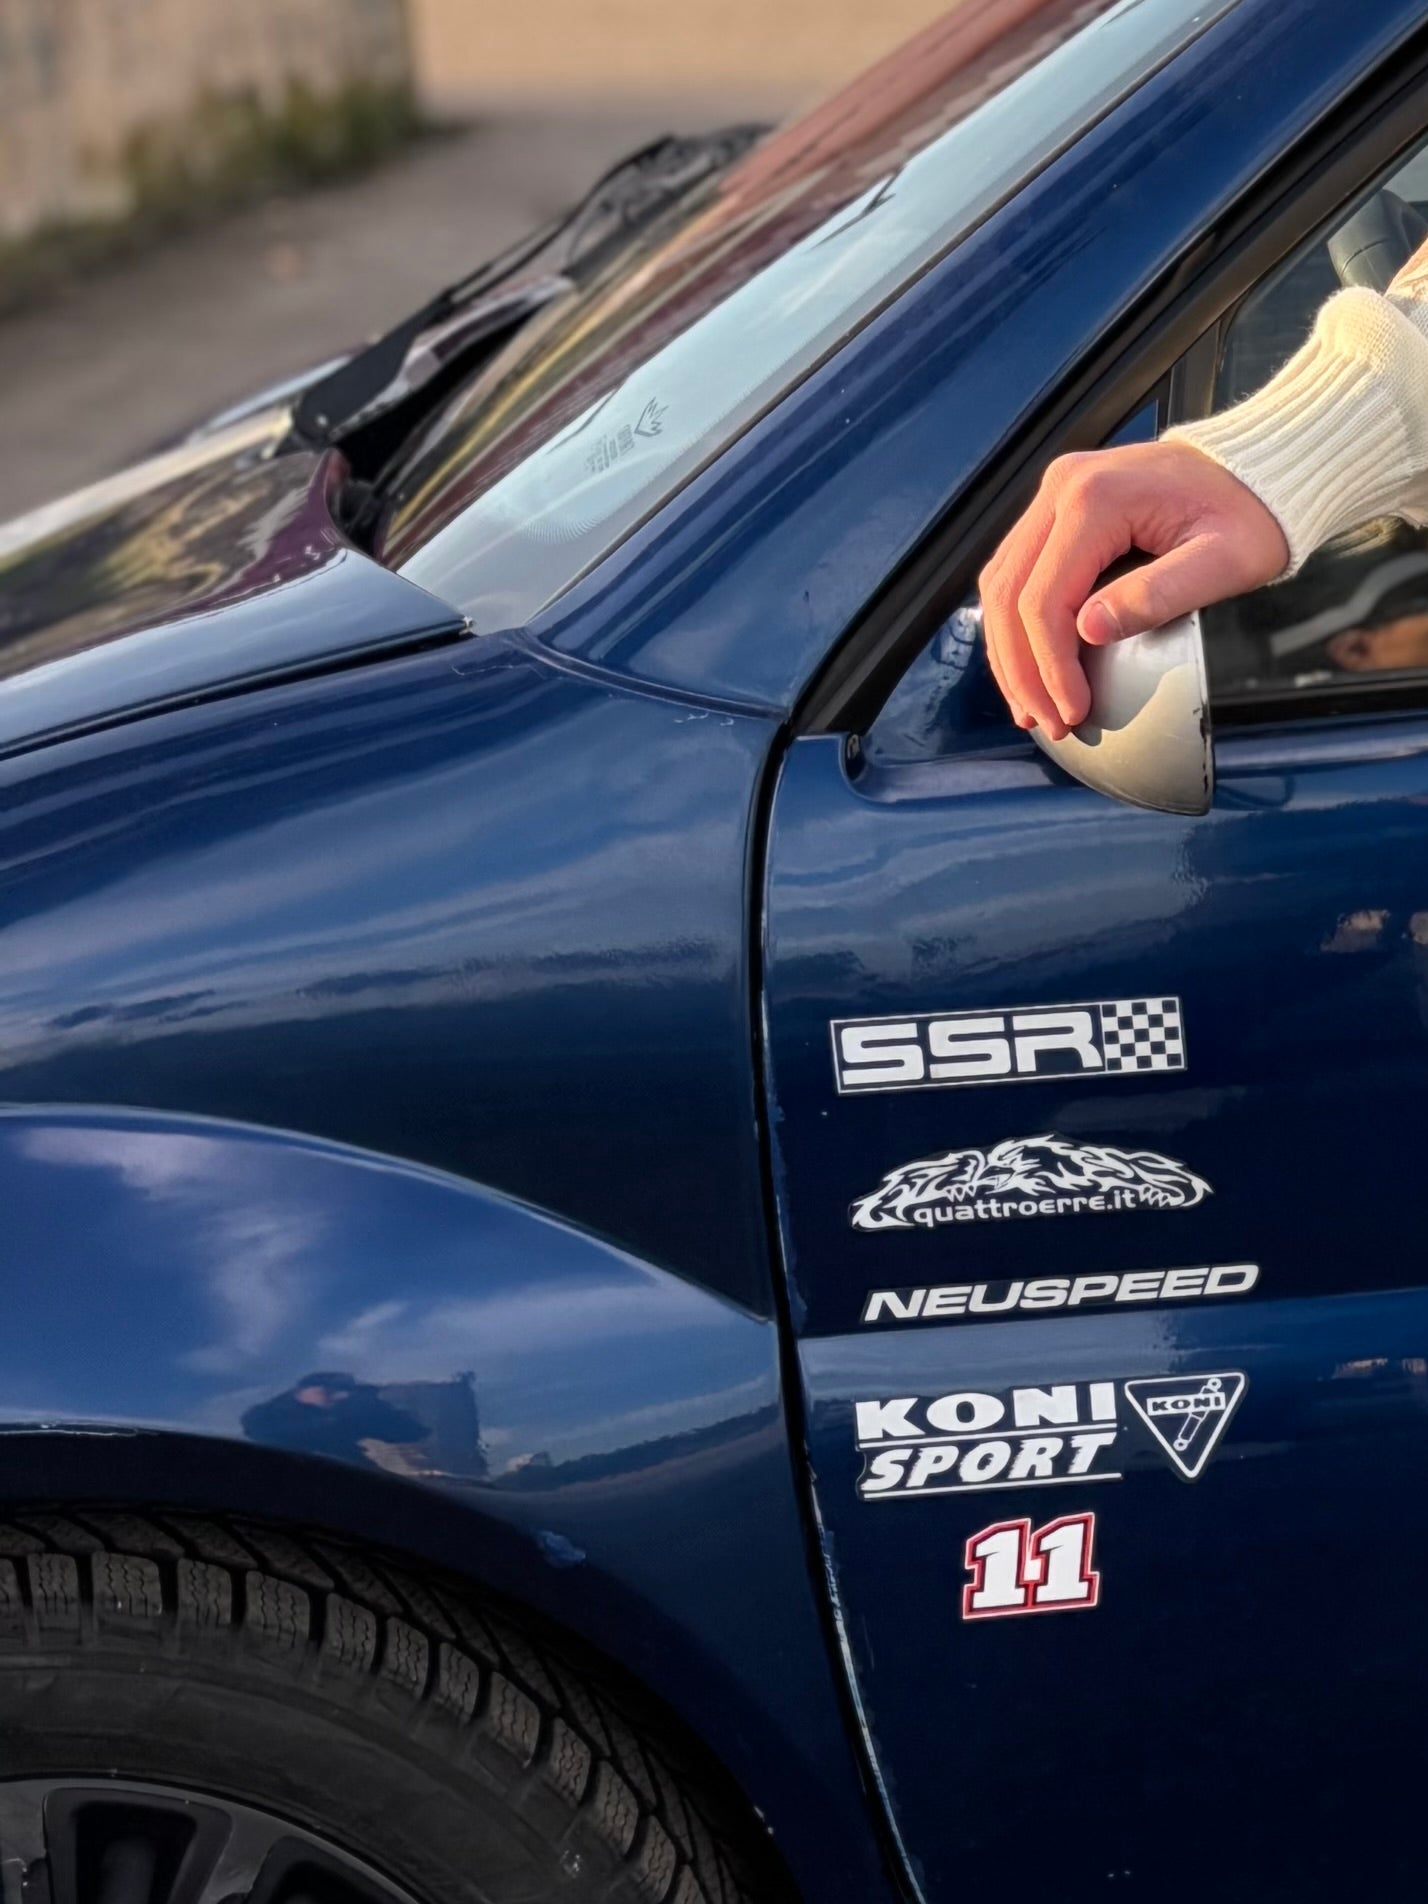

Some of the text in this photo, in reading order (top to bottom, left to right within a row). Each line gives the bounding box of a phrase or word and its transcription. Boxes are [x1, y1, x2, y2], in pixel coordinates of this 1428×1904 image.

[841, 1010, 1104, 1084] SSR
[913, 1191, 1137, 1228] quattroerre.it
[864, 1264, 1260, 1322] NEUSPEED
[856, 1382, 1118, 1441] KONI
[1151, 1395, 1222, 1412] KONI
[863, 1432, 1119, 1492] SPORT
[964, 1514, 1098, 1618] 11
